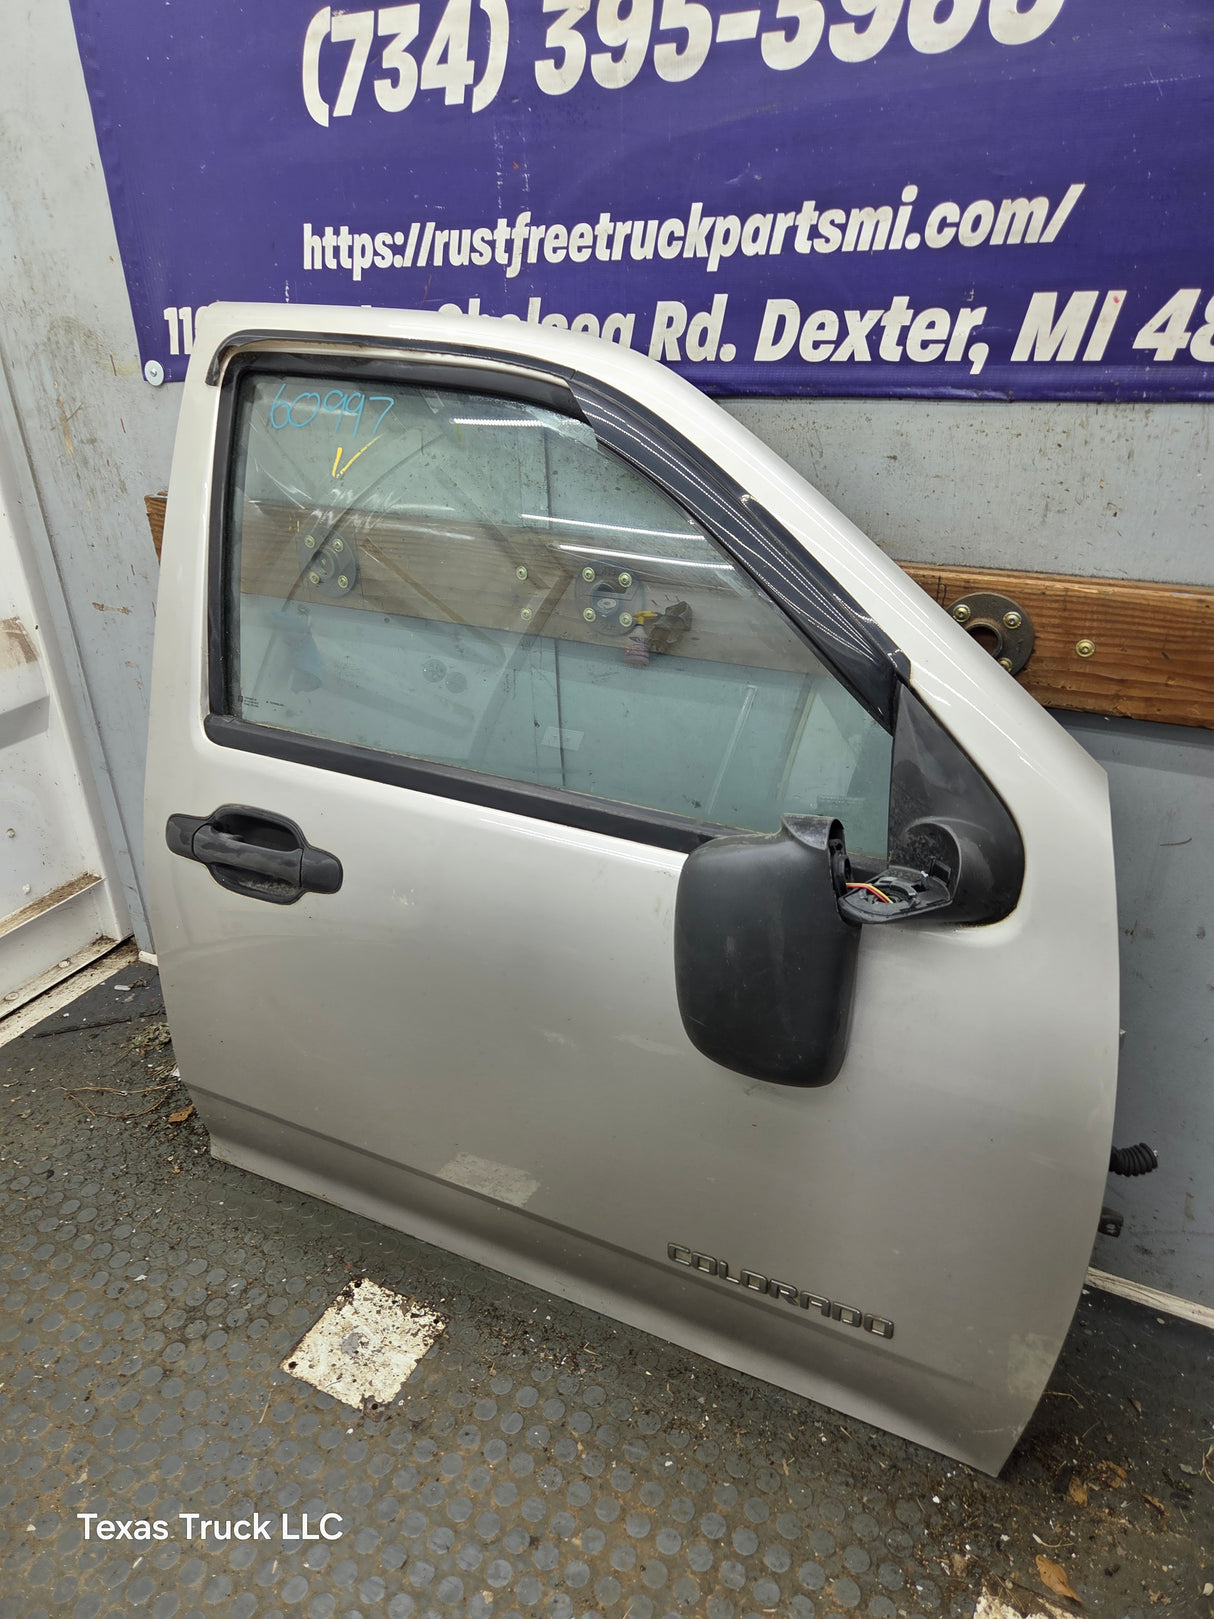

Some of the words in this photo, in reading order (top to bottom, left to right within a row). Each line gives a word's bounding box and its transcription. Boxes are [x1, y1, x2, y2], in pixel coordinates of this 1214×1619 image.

[302, 0, 509, 127] (734)
[303, 183, 1085, 281] https://rustfreetruckpartsmi.com/
[648, 293, 737, 362] Rd.
[754, 295, 990, 375] Dexter,
[1010, 289, 1127, 362] MI
[269, 383, 394, 437] 60997
[667, 1242, 895, 1340] COLORADO
